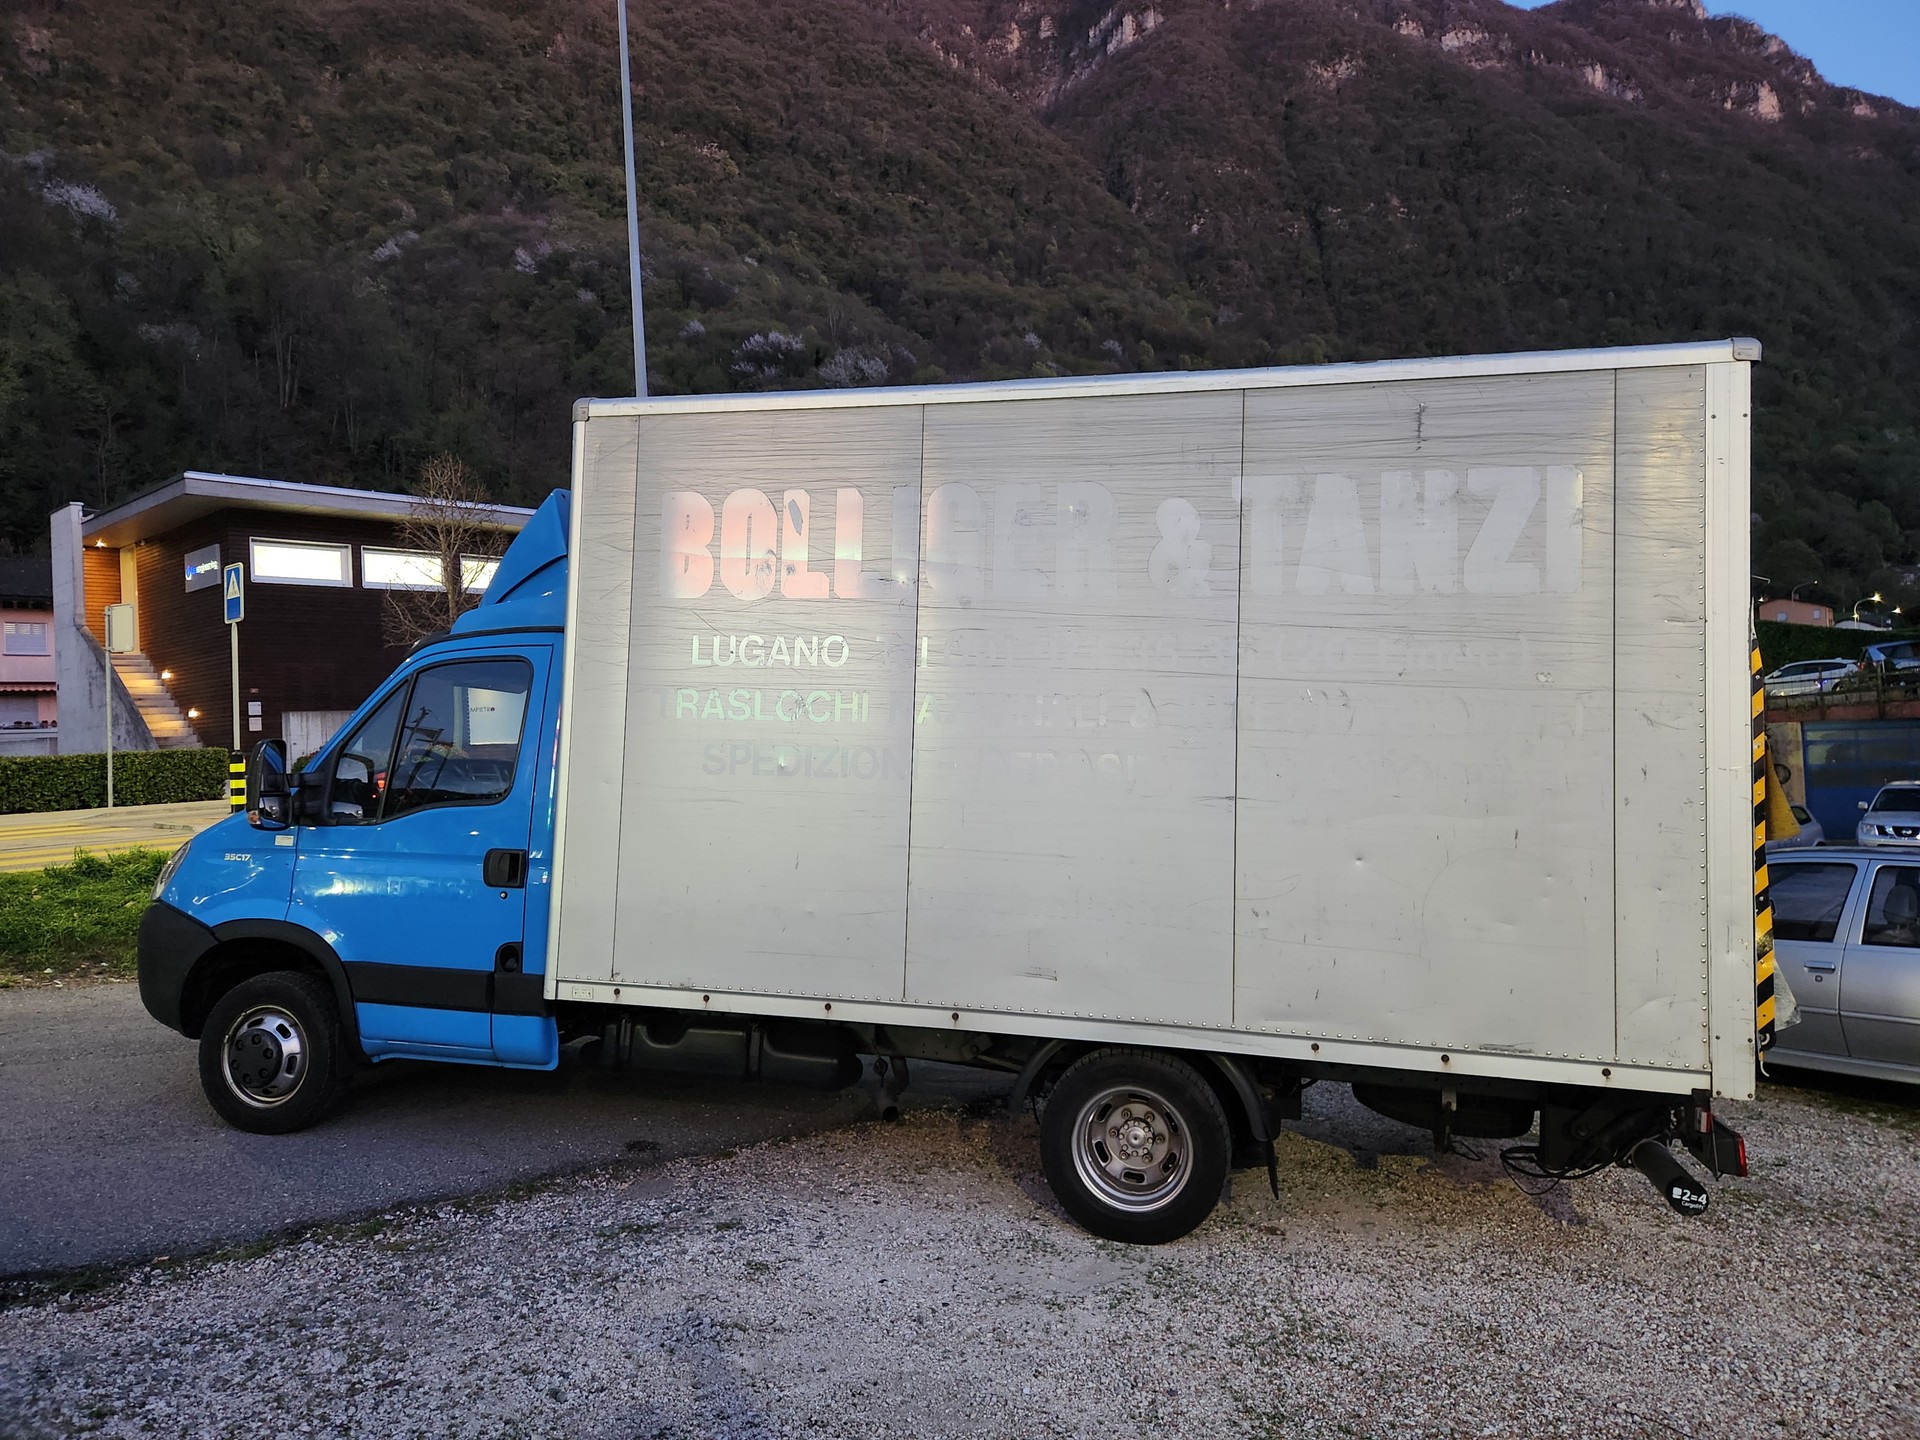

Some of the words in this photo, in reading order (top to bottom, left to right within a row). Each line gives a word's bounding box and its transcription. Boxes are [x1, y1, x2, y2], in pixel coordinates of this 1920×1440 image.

[659, 482, 1118, 600] BOLLIGER
[1148, 497, 1211, 597] &
[1231, 465, 1585, 597] TANZI
[690, 634, 850, 668] LUGANO
[224, 853, 252, 862] 35C17
